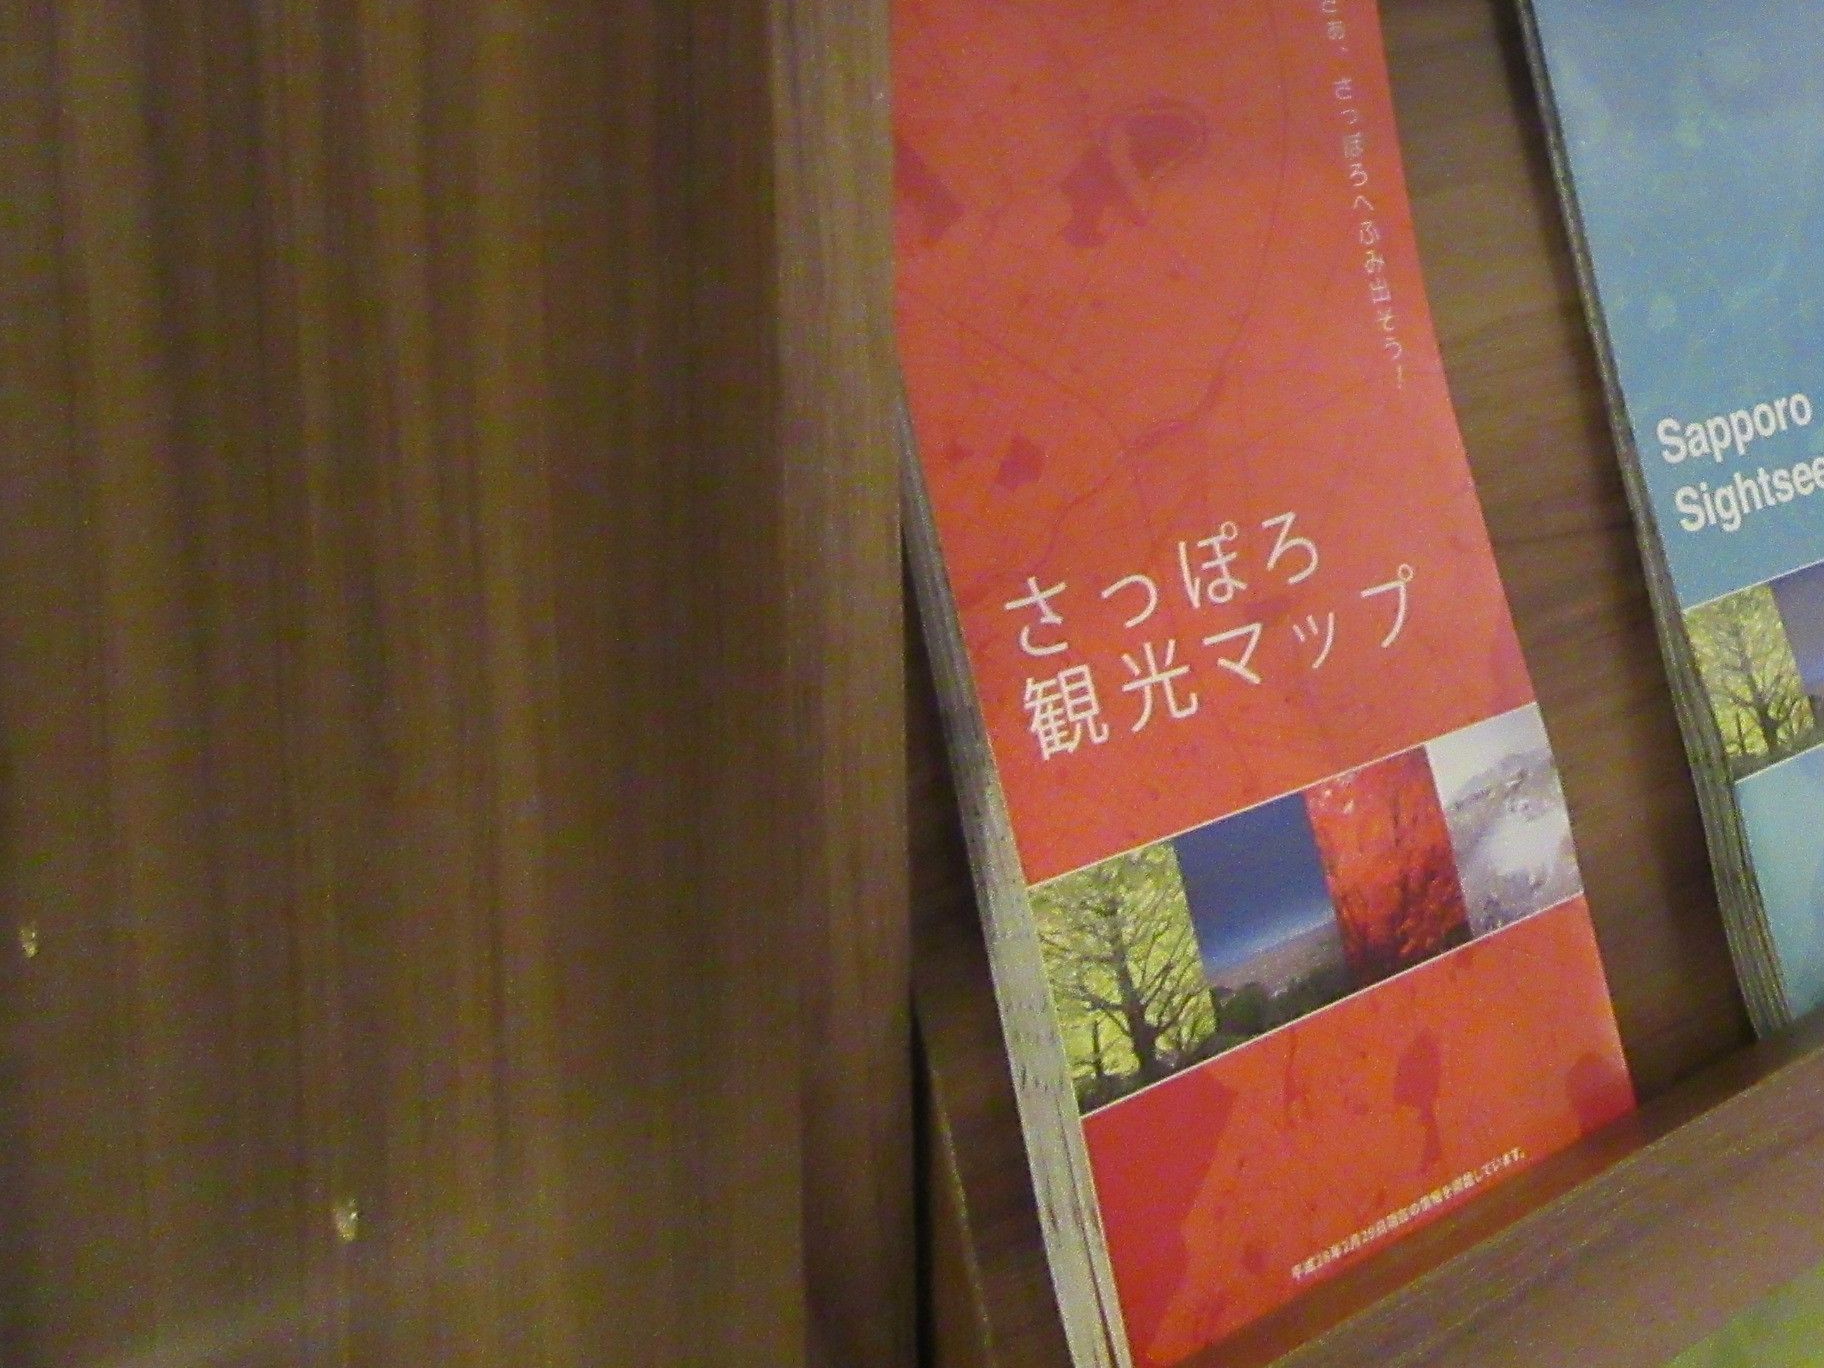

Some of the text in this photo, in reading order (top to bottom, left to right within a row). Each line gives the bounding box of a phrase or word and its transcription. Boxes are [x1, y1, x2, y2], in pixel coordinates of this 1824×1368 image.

[1656, 392, 1814, 468] Sapporo
[1004, 510, 1320, 658] さっぽろ
[1022, 562, 1414, 762] 観光マップ
